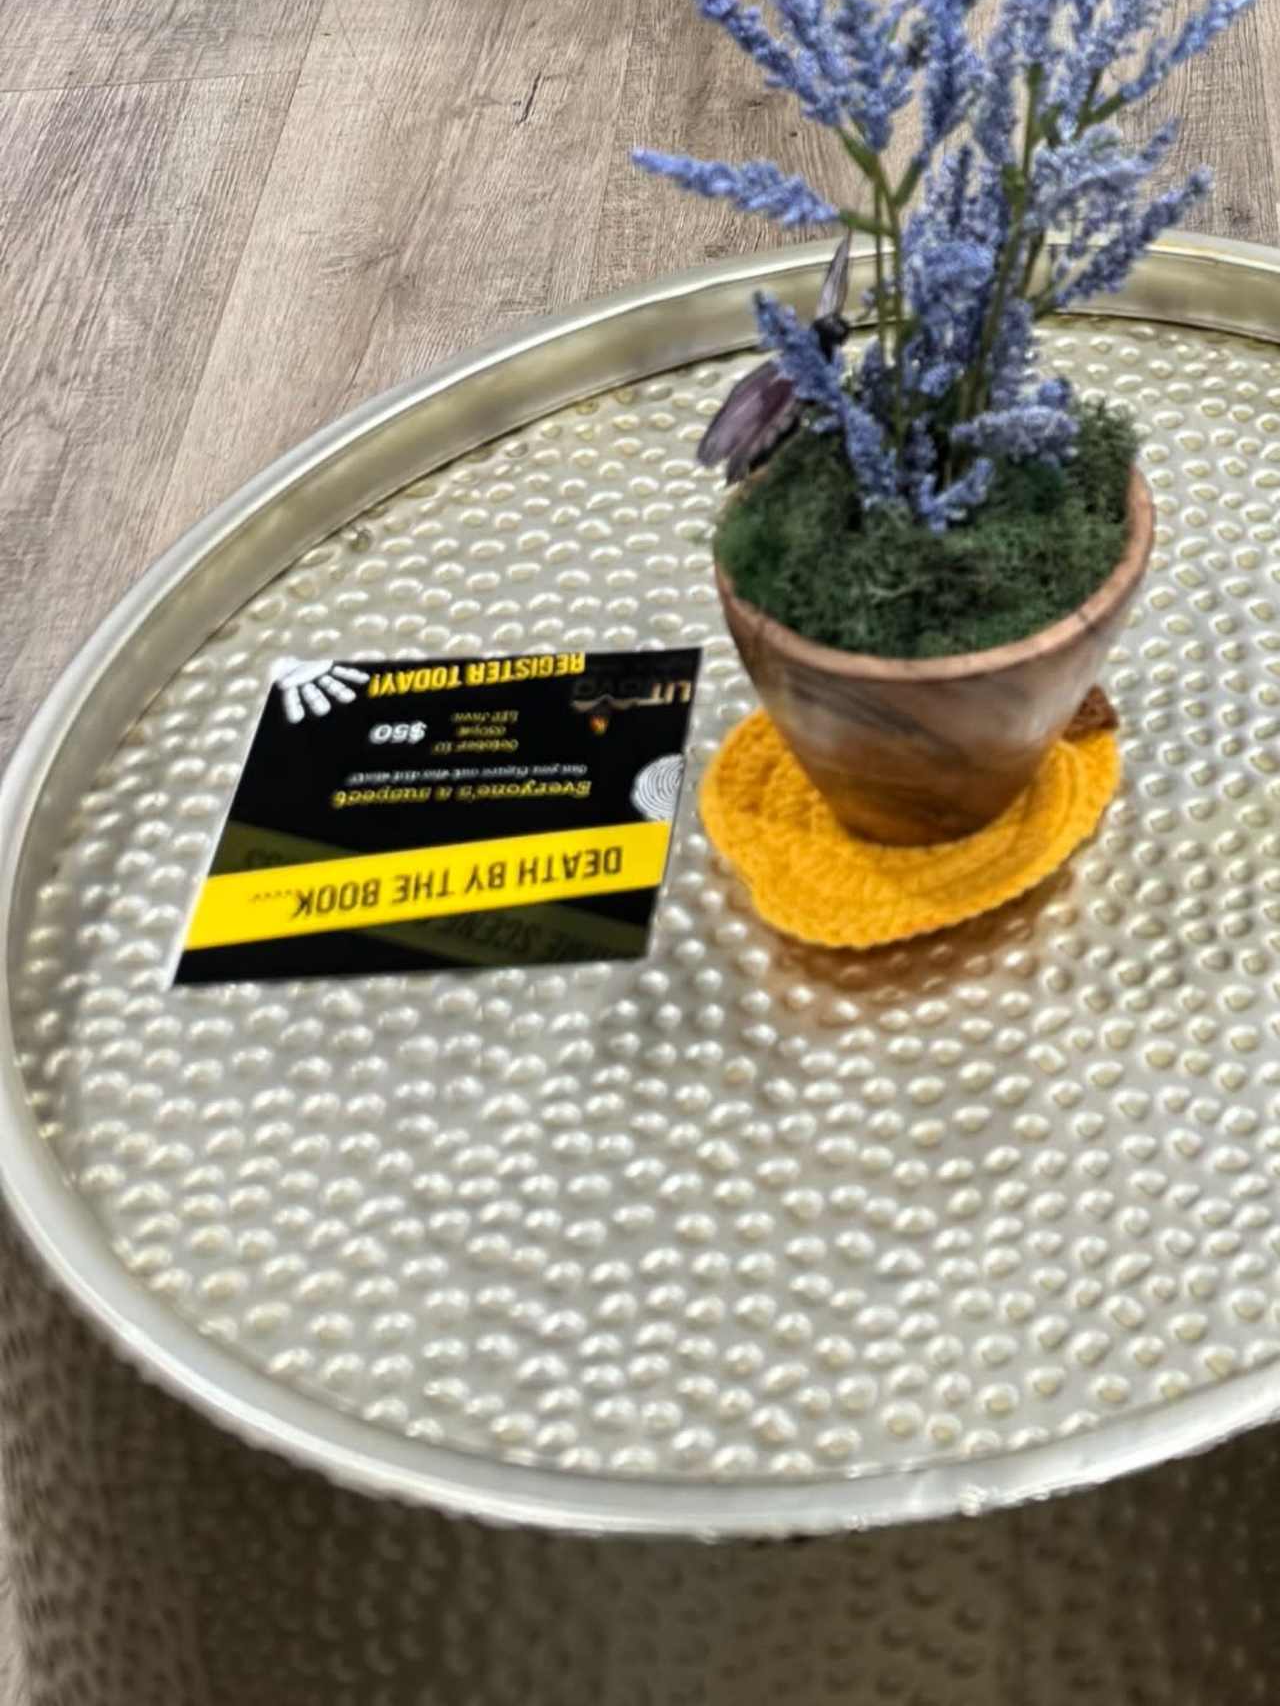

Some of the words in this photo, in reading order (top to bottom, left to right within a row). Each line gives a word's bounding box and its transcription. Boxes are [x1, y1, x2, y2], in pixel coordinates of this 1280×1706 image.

[368, 663, 462, 698] TODAY!
[466, 651, 586, 686] REGISTER
[369, 720, 427, 744] $50
[332, 787, 432, 809] suspect
[466, 780, 592, 799] Everyone's
[464, 861, 504, 890] BY
[517, 846, 624, 879] DEATH
[389, 869, 453, 904] THE
